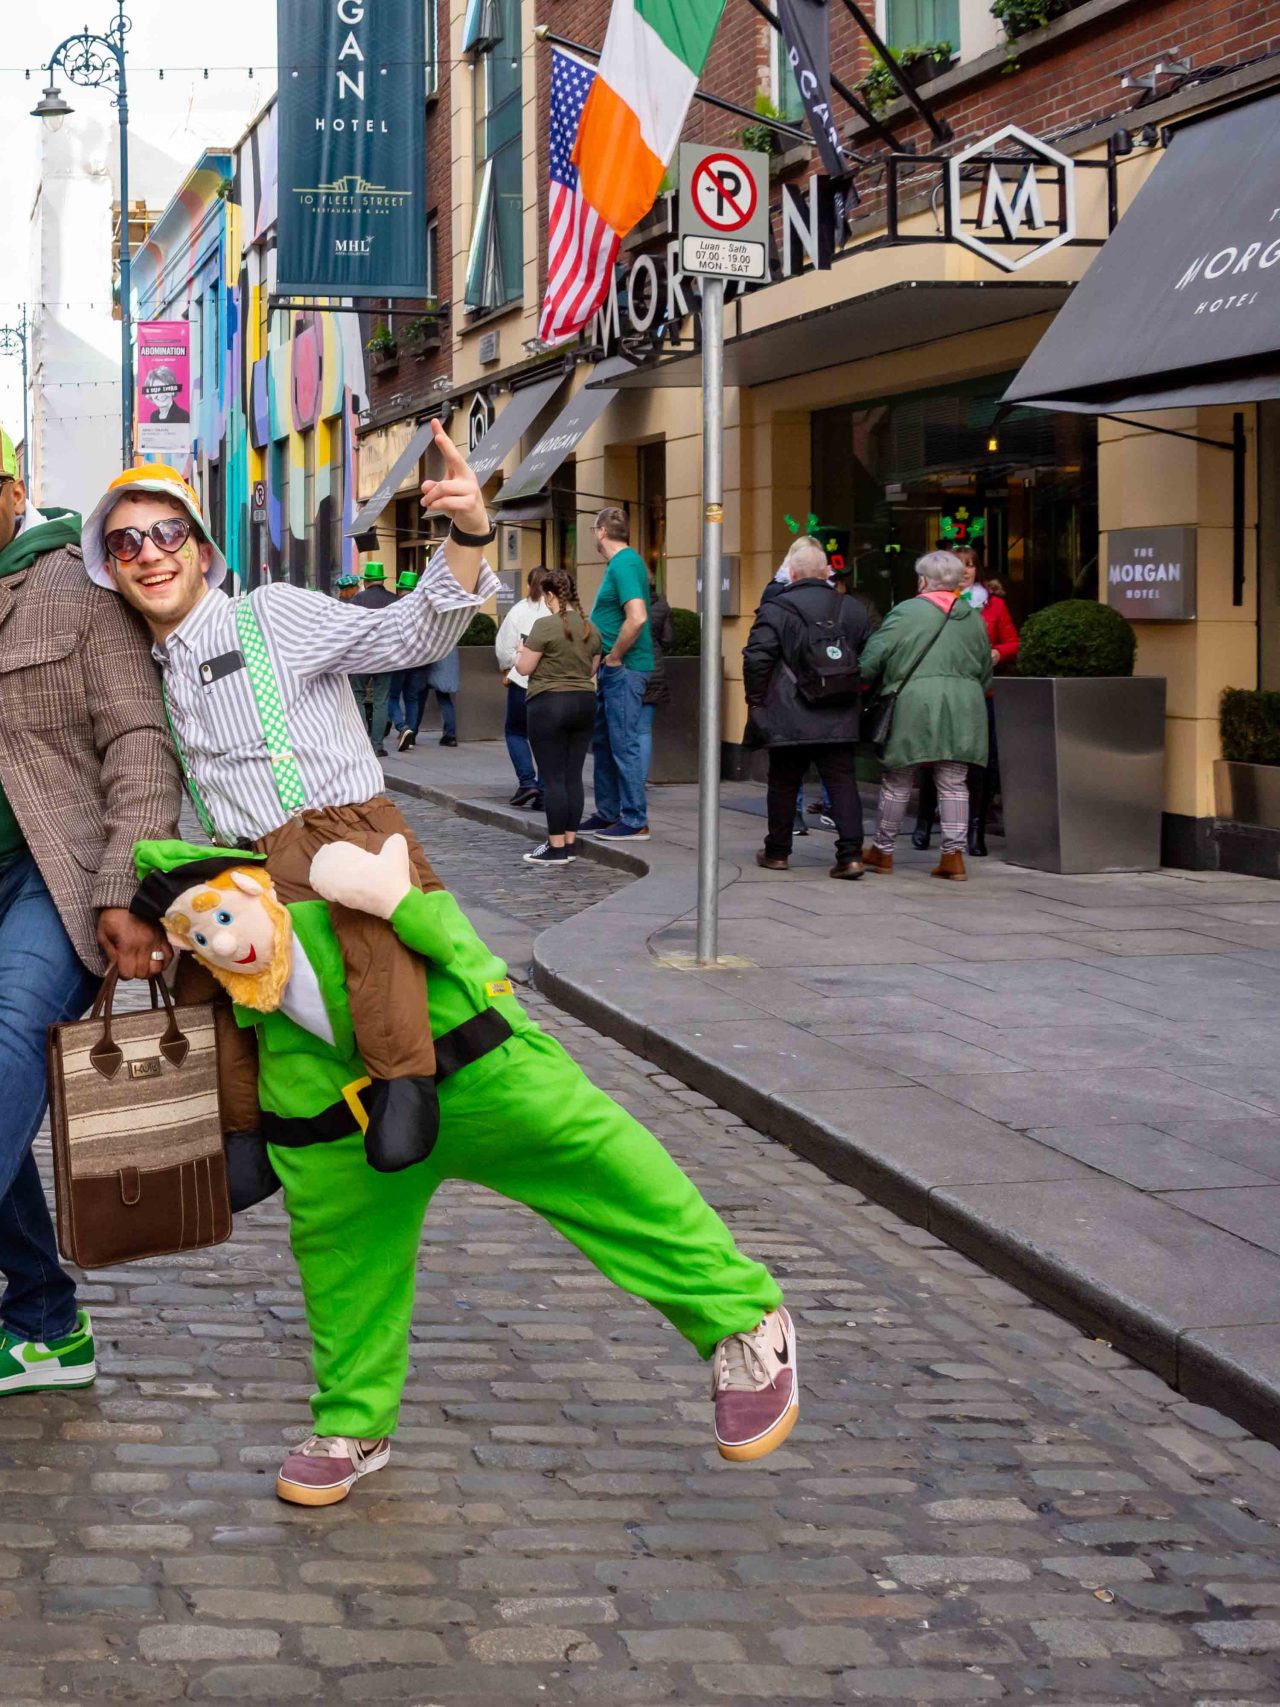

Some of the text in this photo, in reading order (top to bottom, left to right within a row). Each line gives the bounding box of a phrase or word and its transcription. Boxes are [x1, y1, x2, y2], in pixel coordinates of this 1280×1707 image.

[316, 118, 388, 133] HOTEL
[322, 196, 354, 205] FLEET
[362, 196, 404, 207] STREET
[335, 240, 370, 252] MHL
[700, 241, 720, 251] Luan
[695, 250, 719, 261] 07.00
[728, 254, 751, 264] 19.00
[699, 261, 722, 271] MON
[731, 263, 750, 273] SAT
[141, 346, 186, 356] ABOMINATION
[1133, 547, 1154, 558] THE
[1109, 563, 1180, 585] MORGAN
[1126, 589, 1160, 599] HOTEL
